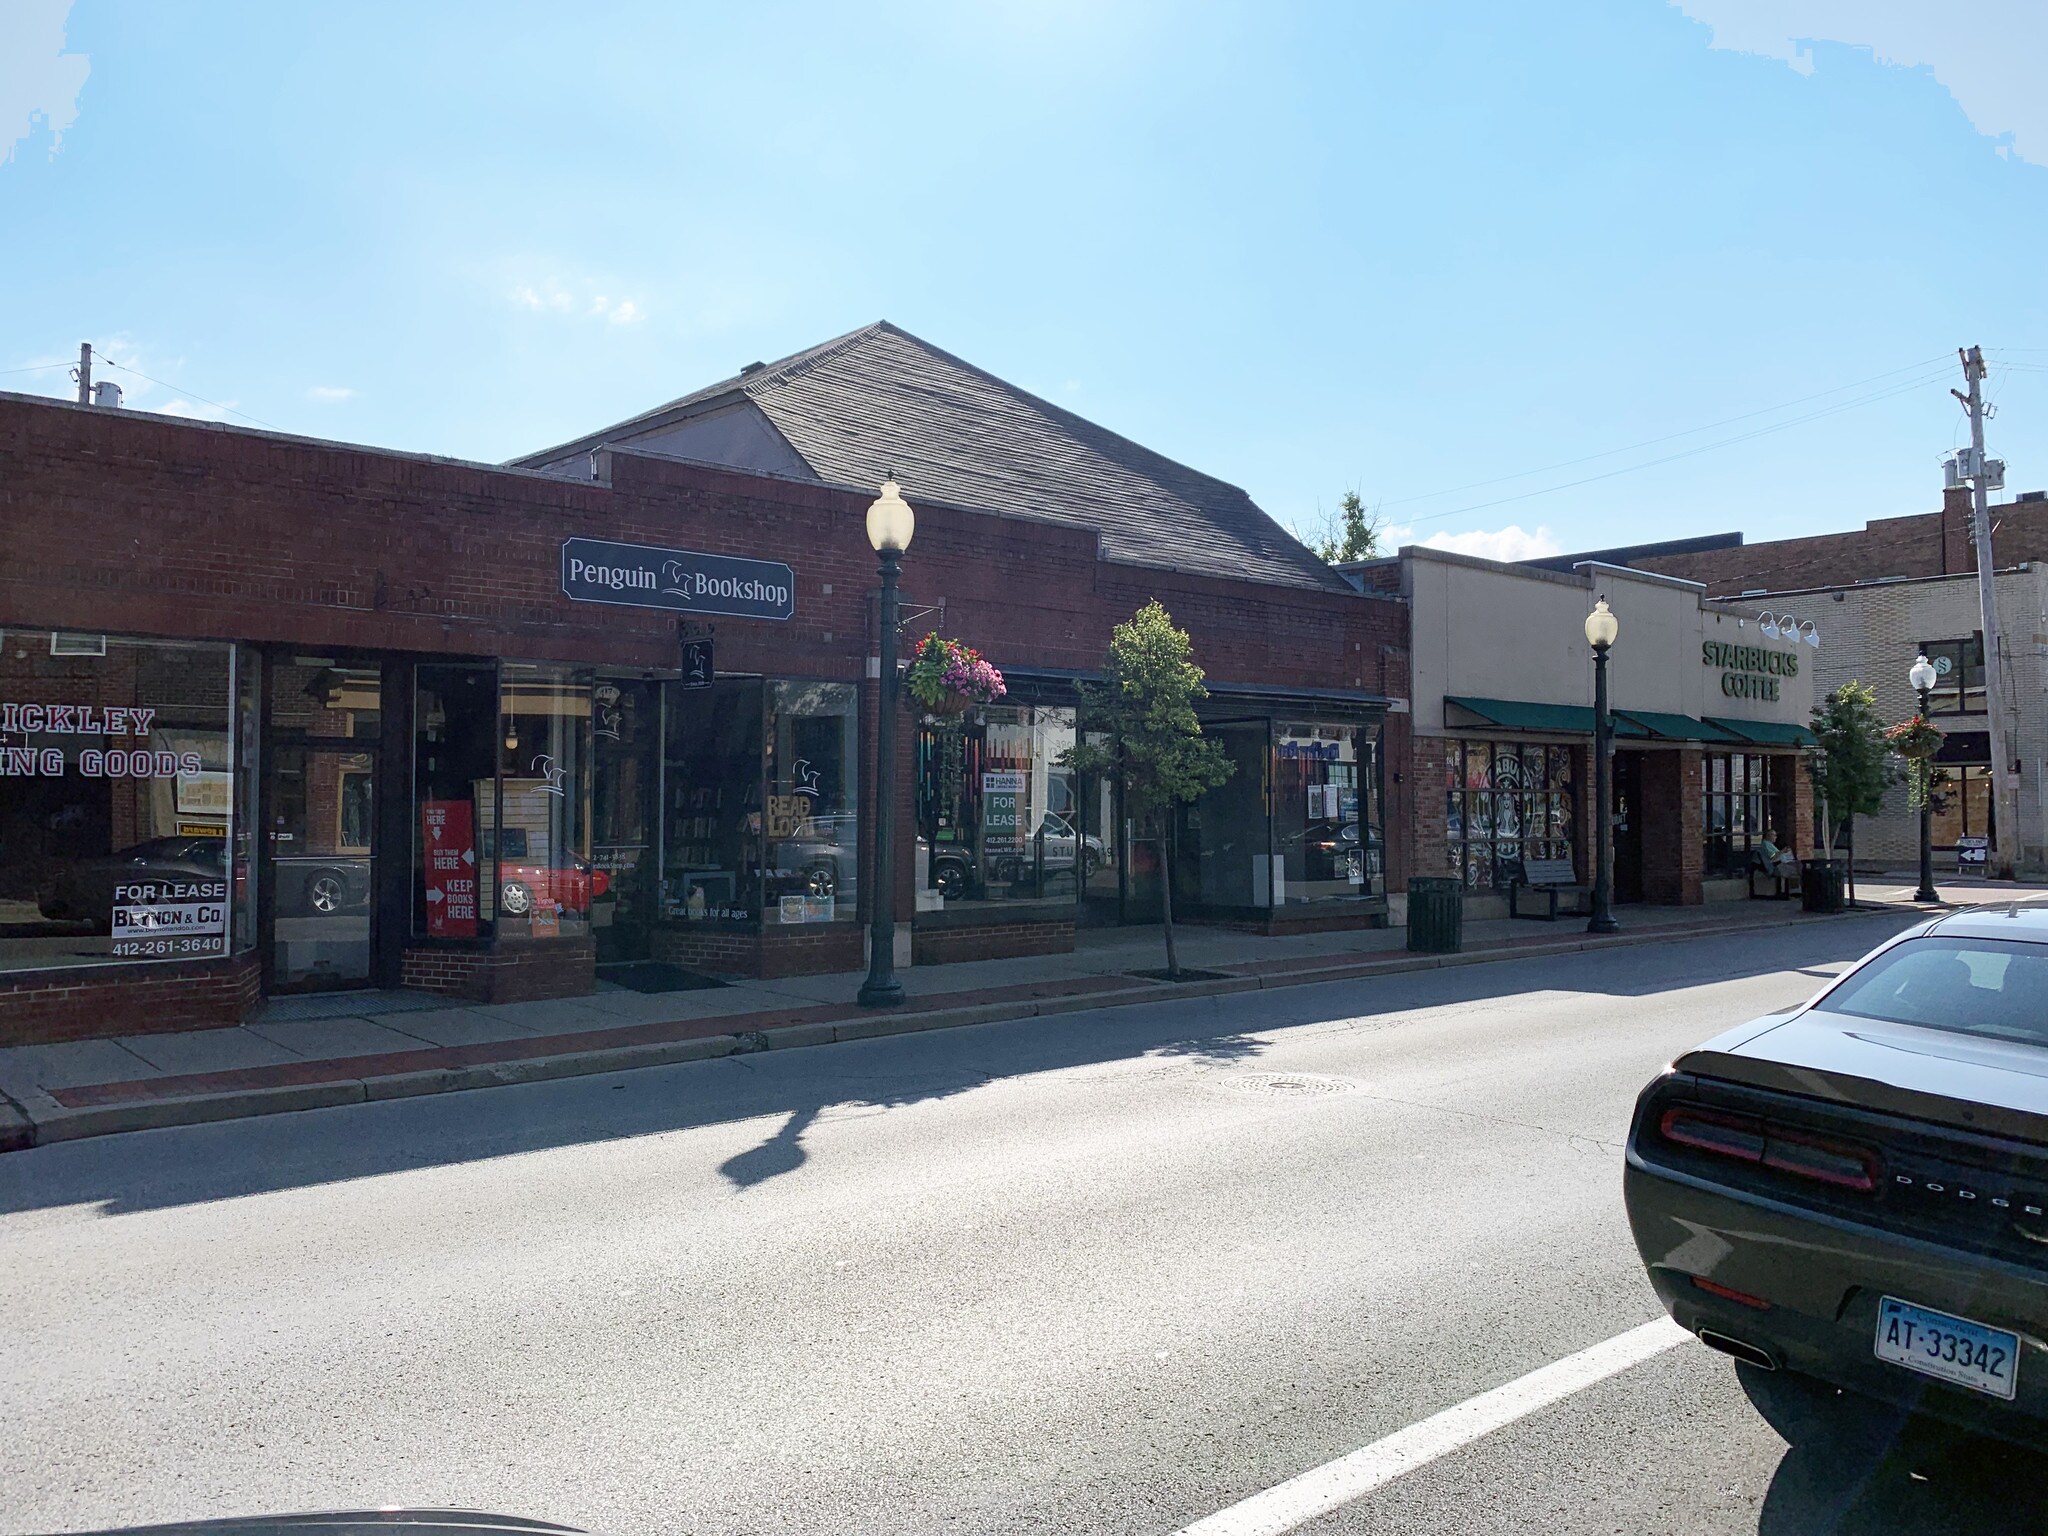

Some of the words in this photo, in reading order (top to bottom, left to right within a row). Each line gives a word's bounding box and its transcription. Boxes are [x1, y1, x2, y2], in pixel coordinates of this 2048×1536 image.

[570, 558, 657, 590] Penguin
[695, 572, 788, 607] Bookshop
[1702, 640, 1799, 677] STARBUCKS
[1721, 671, 1780, 702] COFFEE
[2, 702, 156, 736] ICKLEY
[79, 749, 201, 778] GOODS
[996, 777, 1023, 785] HANNA
[767, 795, 811, 816] READ
[993, 796, 1016, 809] FOR
[426, 815, 446, 825] HERE
[986, 814, 1022, 826] LEASE
[434, 857, 460, 869] HERE
[115, 884, 156, 900] FOR
[162, 883, 225, 898] LEASE
[446, 879, 473, 892] KEEP
[447, 894, 474, 904] BOOKS
[185, 913, 193, 924] &
[447, 905, 474, 919] HERE
[668, 906, 686, 916] Great
[688, 907, 708, 917] books
[709, 907, 719, 917] for
[721, 908, 729, 918] all
[731, 909, 748, 920] ages
[112, 938, 222, 956] 412-261-3640
[1896, 1175, 2043, 1216] DODGE
